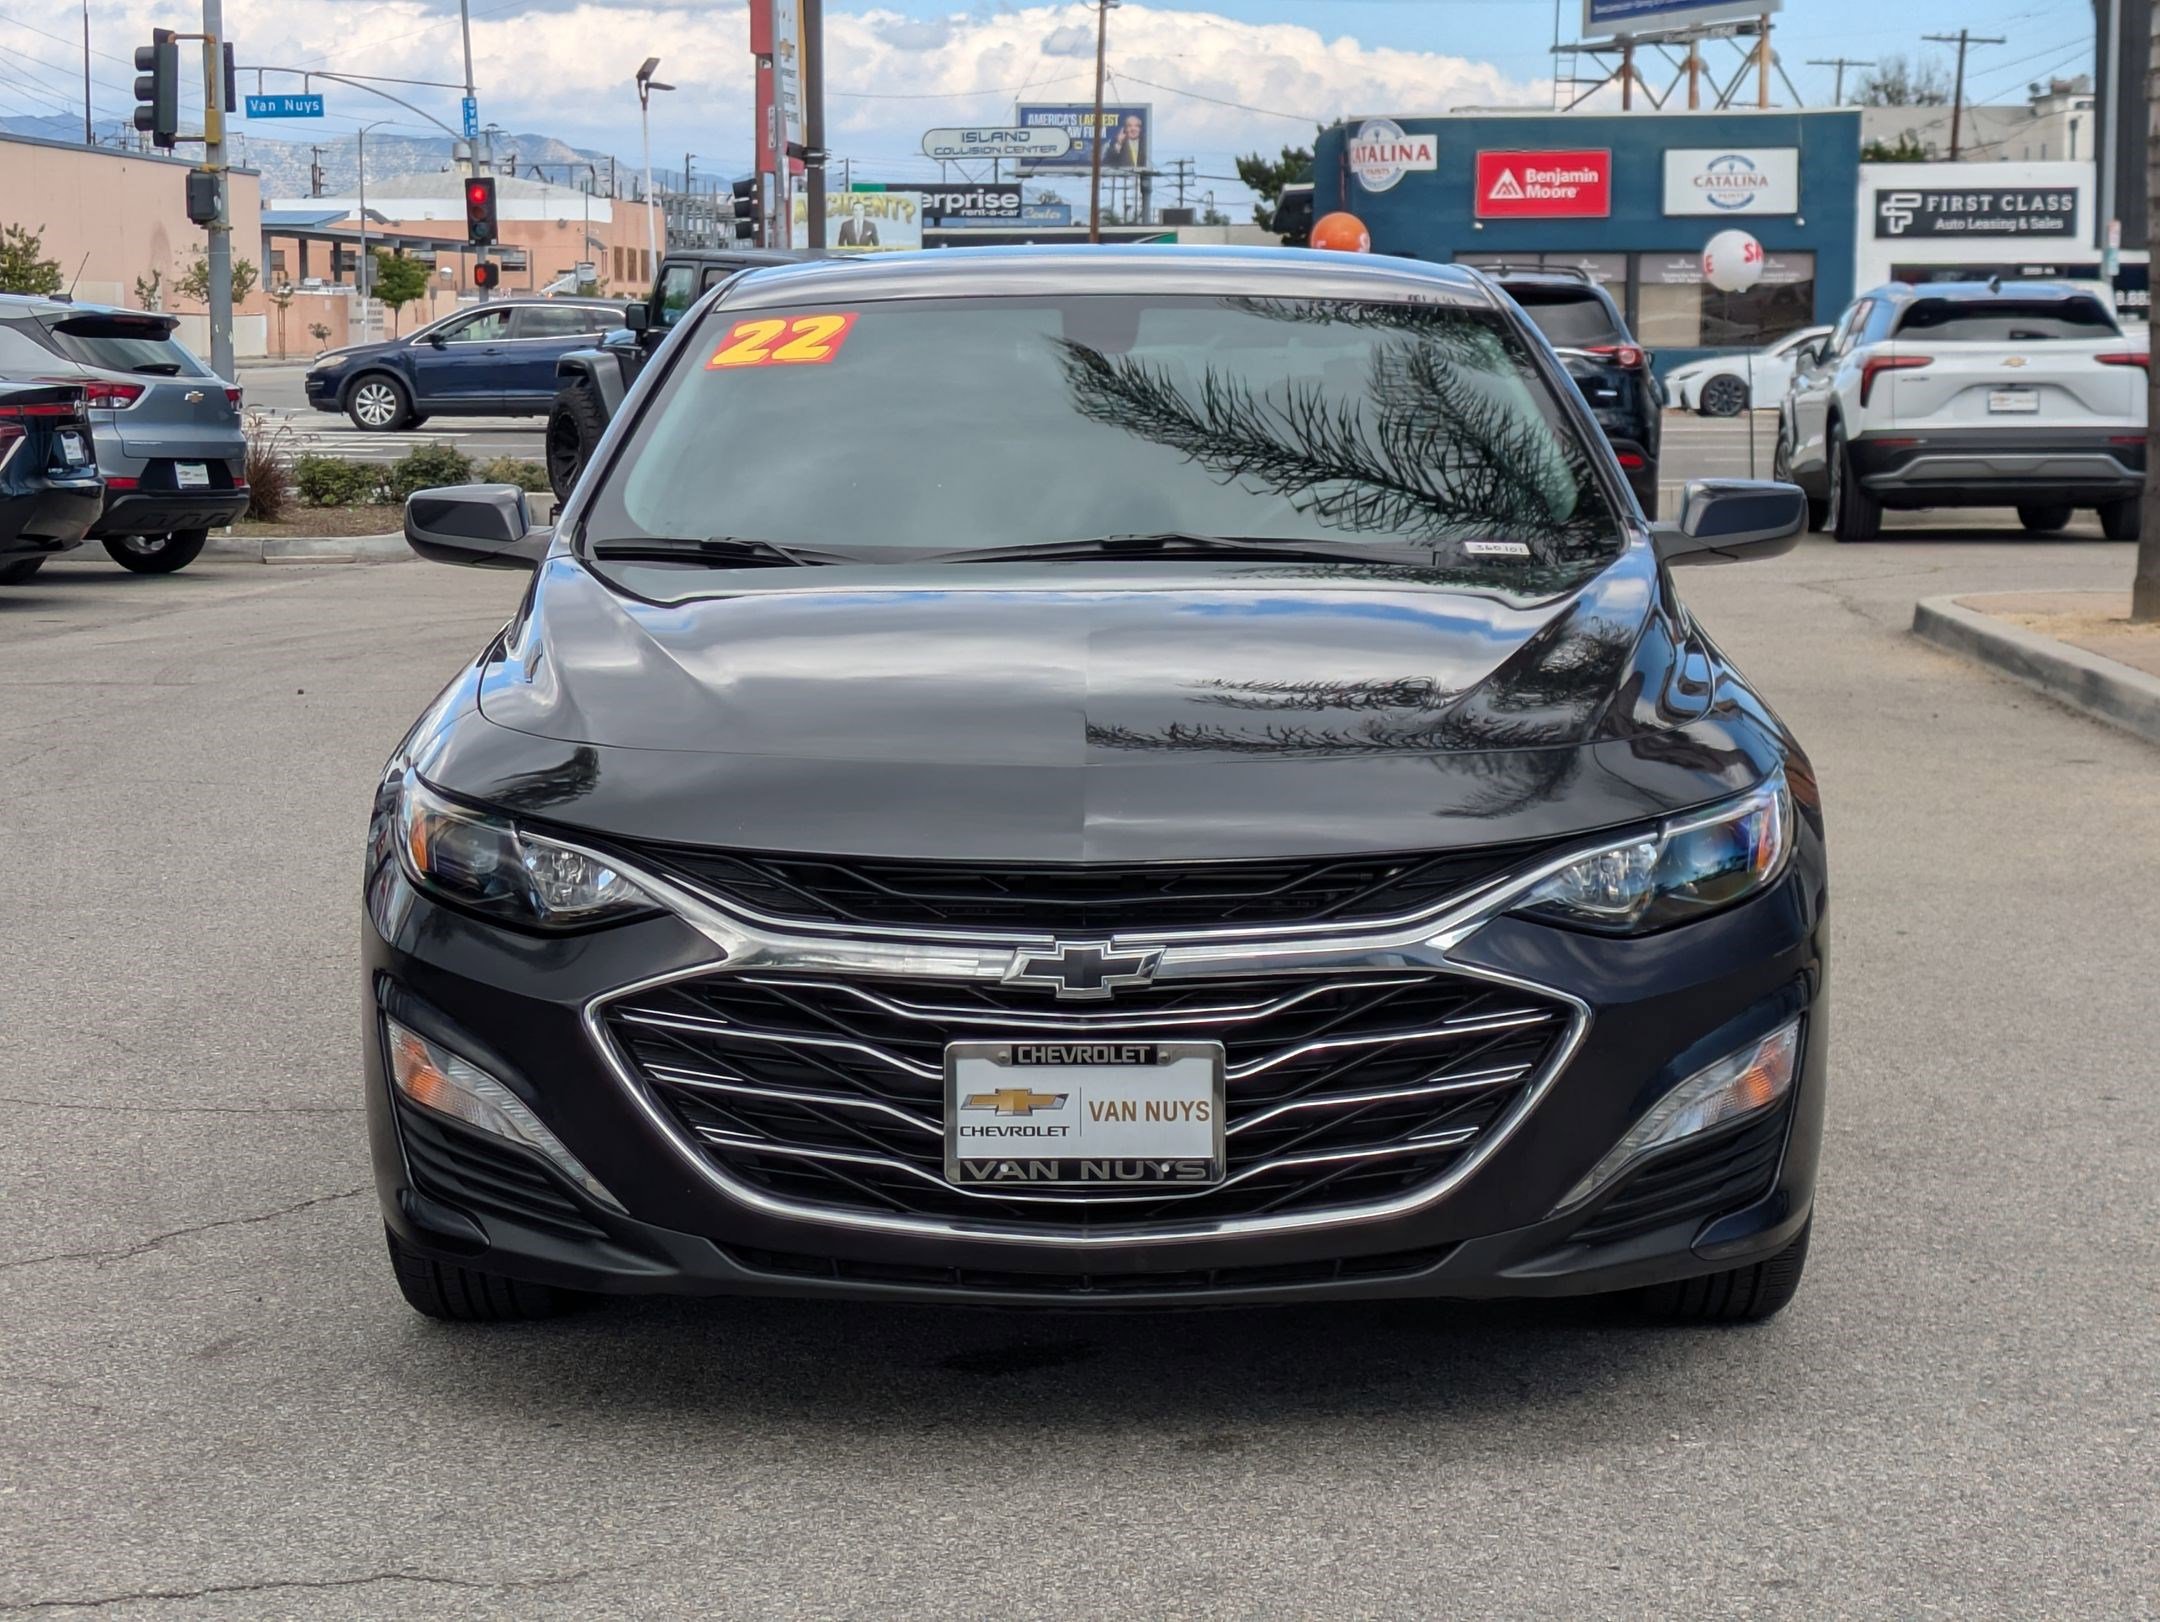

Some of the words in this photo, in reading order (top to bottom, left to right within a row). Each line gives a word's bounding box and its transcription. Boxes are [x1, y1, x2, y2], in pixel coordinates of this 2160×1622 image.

[249, 99, 276, 112] Van
[284, 99, 320, 113] Nuys
[1028, 113, 1077, 126] AMERICA'S
[1079, 113, 1120, 126] LAREST
[961, 131, 1030, 143] ISLAND
[1067, 126, 1083, 139] AW
[934, 146, 1000, 156] COLLISION
[1004, 145, 1057, 154] CENTER
[1525, 167, 1599, 186] Benjamin
[1693, 175, 1769, 188] CATALINA
[1525, 184, 1577, 199] Moore
[922, 188, 1019, 213] erprise
[1926, 194, 1993, 213] FIRST
[2001, 194, 2073, 212] CLASS
[793, 193, 917, 224] ACIDENT?
[960, 208, 1019, 217] rent-a-car
[1935, 217, 1966, 231] Auto
[1967, 217, 2017, 232] Leasing
[2018, 217, 2028, 230] &
[2030, 216, 2064, 230] Sales
[712, 315, 847, 367] 22
[1017, 1045, 1150, 1064] CHEVROLET
[1088, 1100, 1137, 1122] VAN
[1145, 1100, 1211, 1122] NUYS
[959, 1125, 1070, 1137] CHEVROLET
[963, 1160, 1059, 1180] VAN
[1080, 1160, 1207, 1180] NUYS
